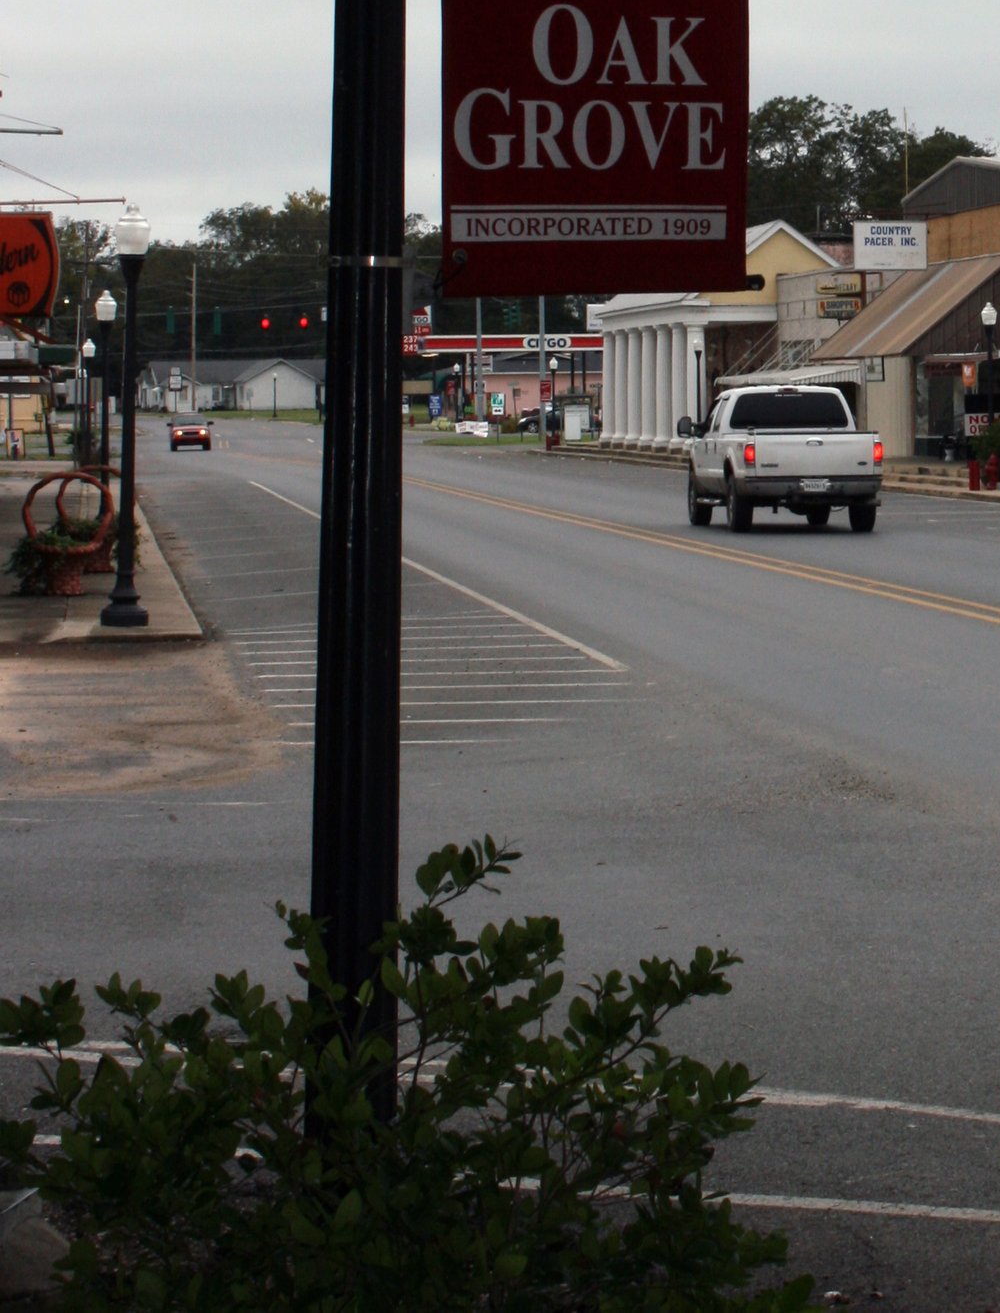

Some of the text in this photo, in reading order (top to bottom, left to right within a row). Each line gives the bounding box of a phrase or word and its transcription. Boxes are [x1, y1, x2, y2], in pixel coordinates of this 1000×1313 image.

[531, 3, 708, 87] OAK
[453, 86, 727, 171] GROVE
[465, 217, 712, 238] INCORPORATED 1909
[870, 226, 912, 236] COUNTRY
[527, 337, 567, 349] CIGO
